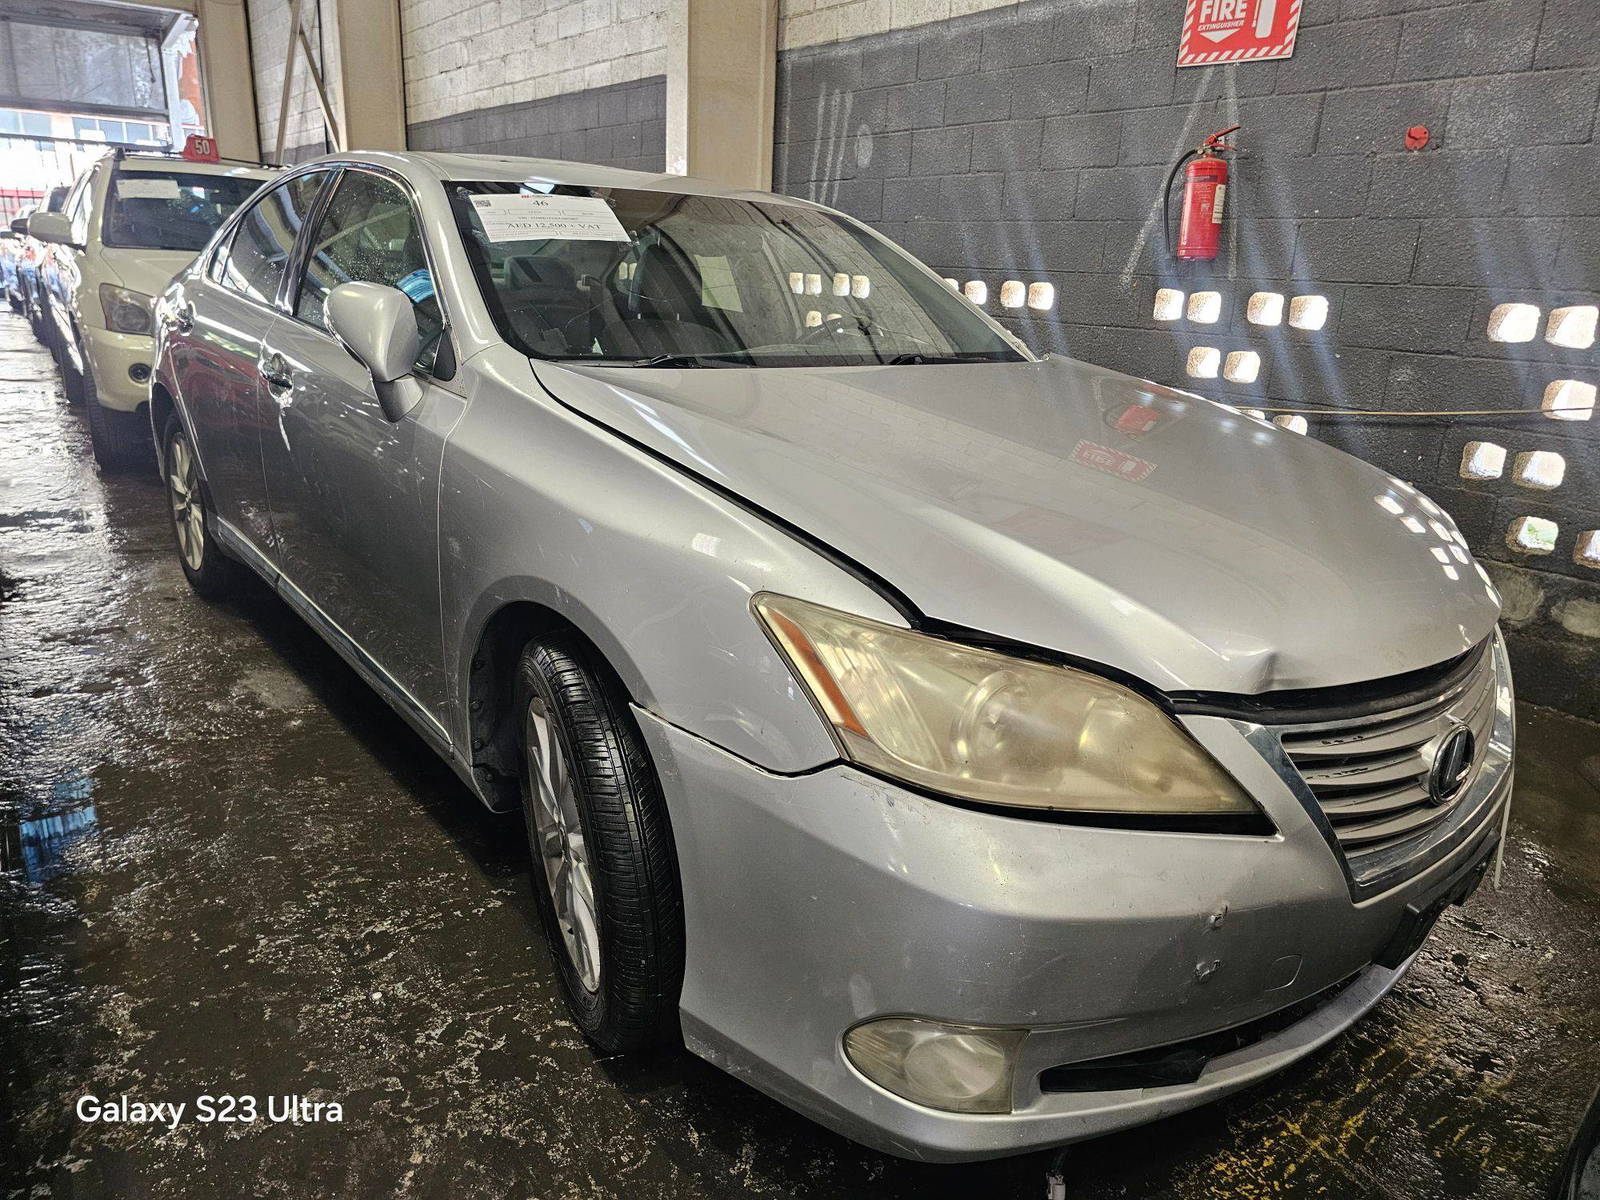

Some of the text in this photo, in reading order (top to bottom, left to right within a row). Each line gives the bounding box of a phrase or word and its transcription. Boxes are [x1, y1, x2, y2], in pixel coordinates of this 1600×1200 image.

[1199, 0, 1248, 23] FIRE
[1197, 20, 1244, 32] EXTINGUISHER
[194, 139, 210, 155] 50
